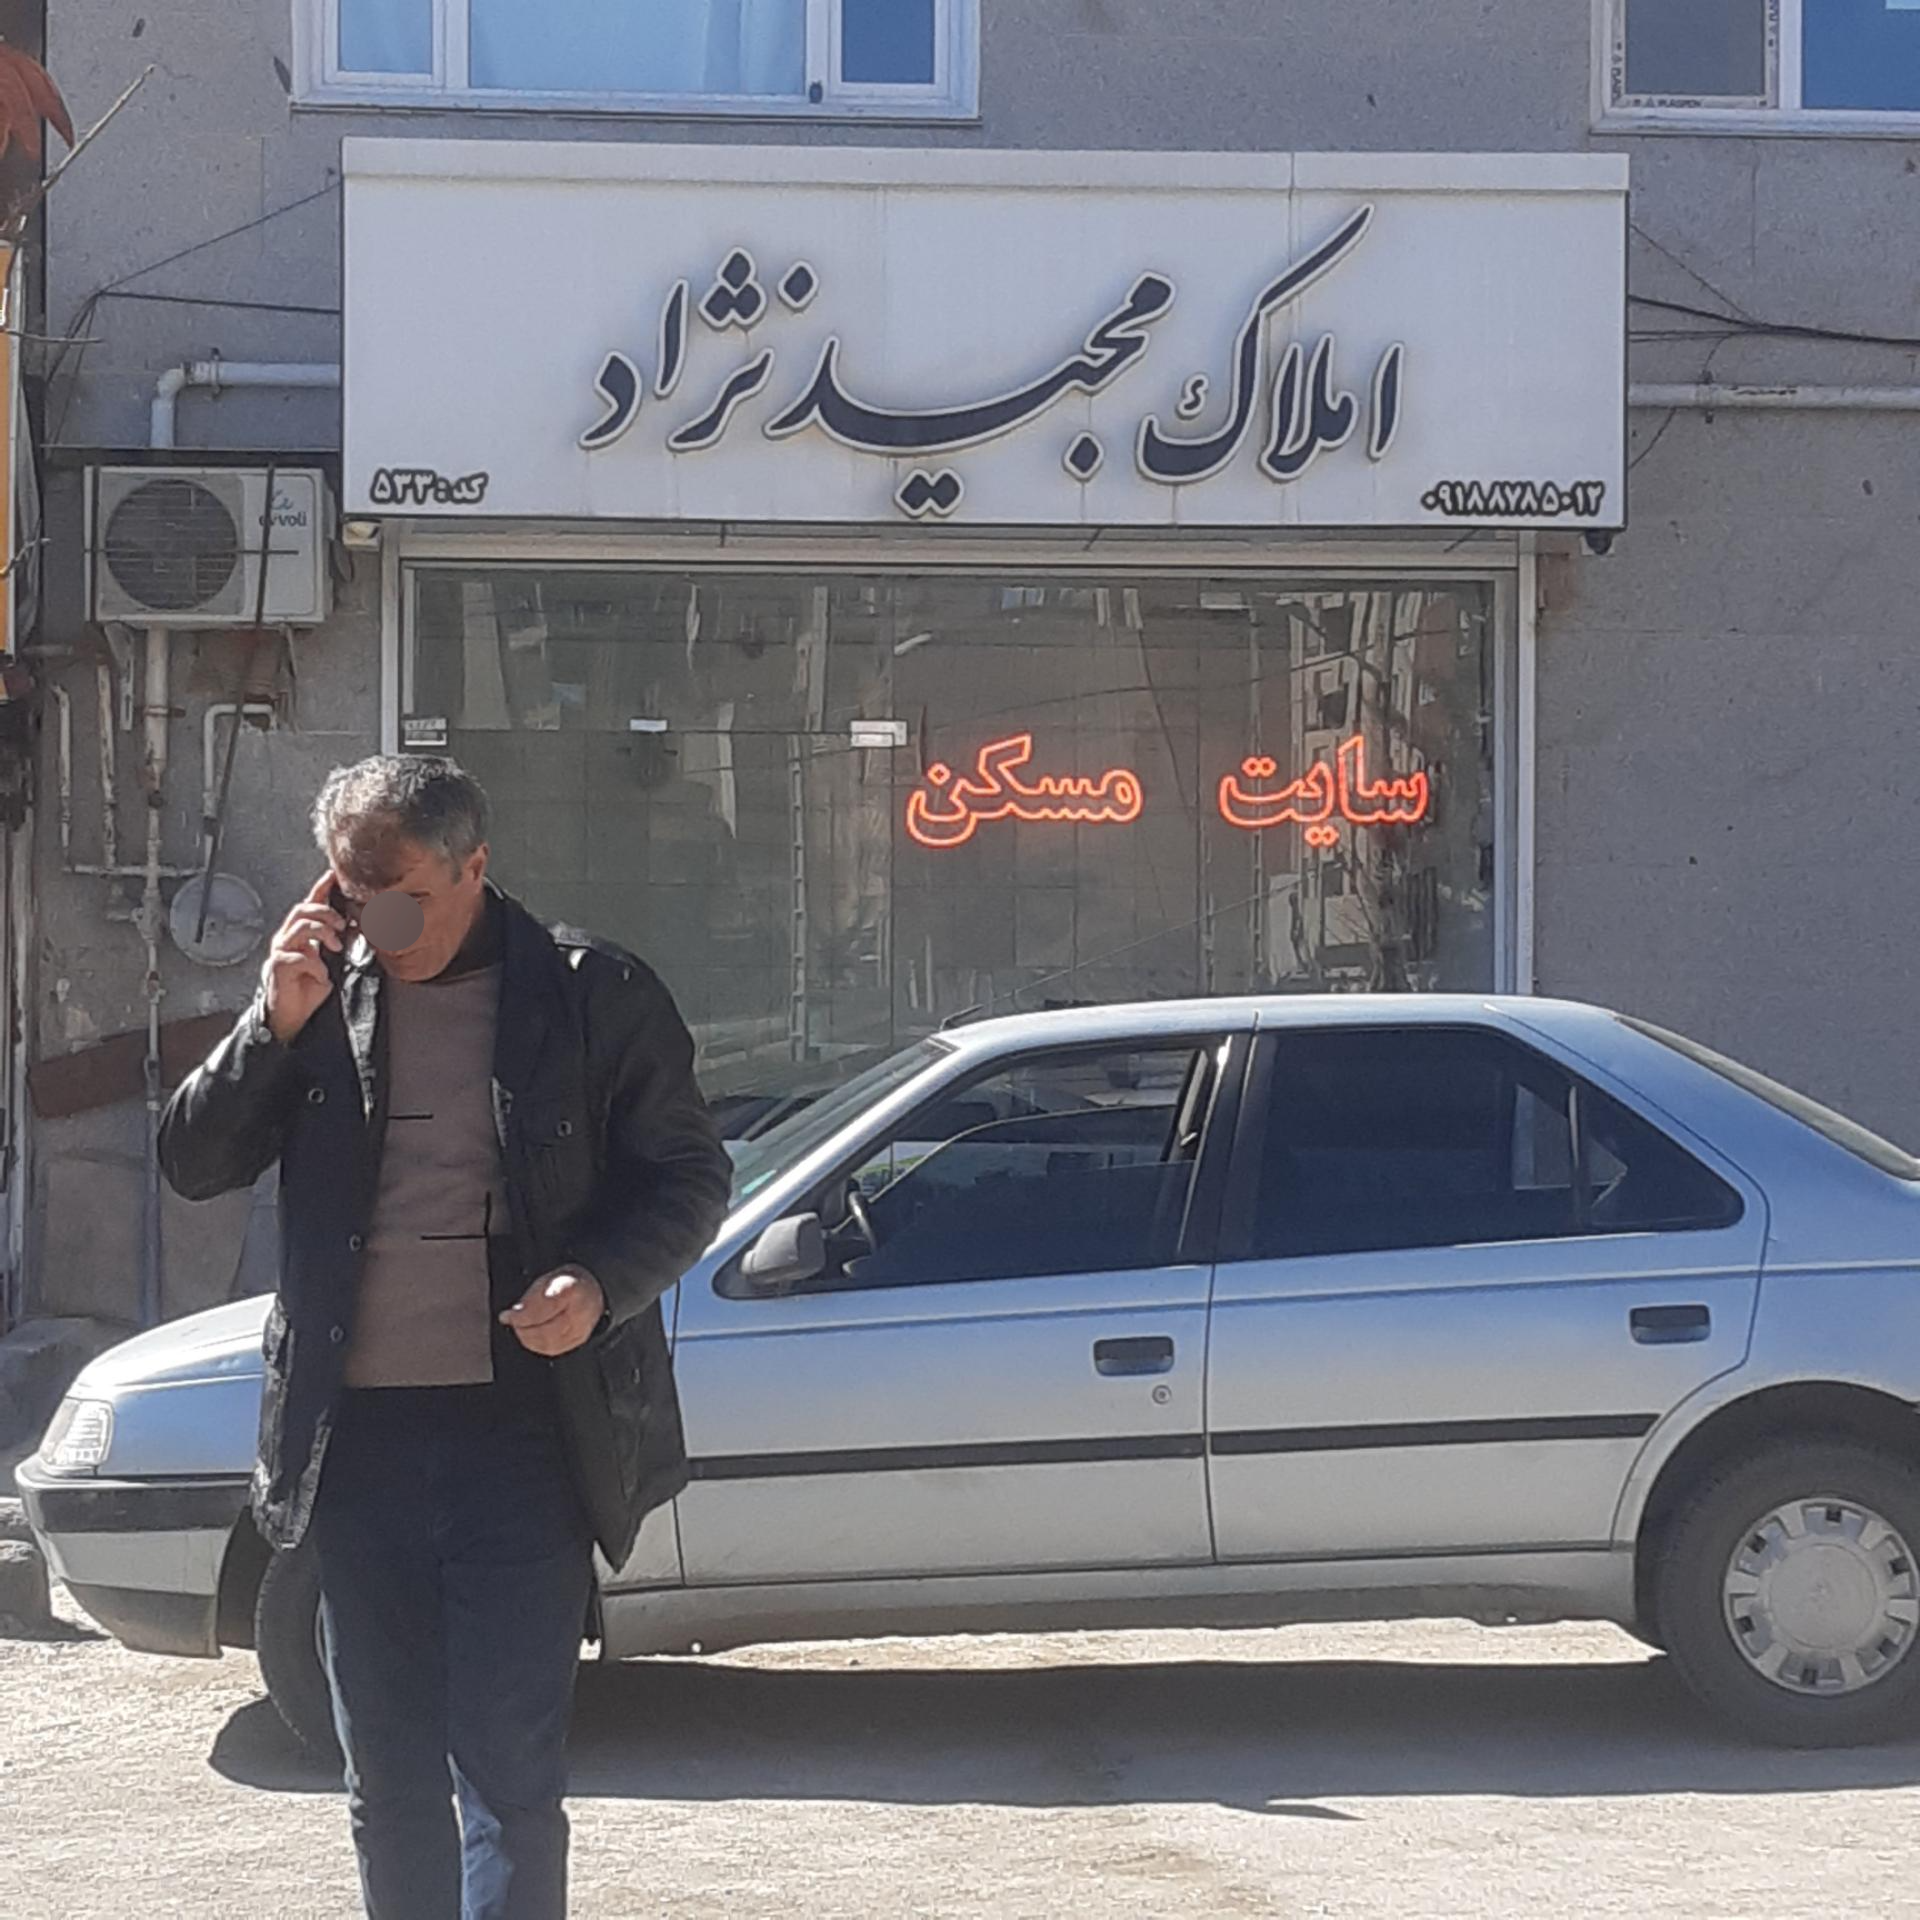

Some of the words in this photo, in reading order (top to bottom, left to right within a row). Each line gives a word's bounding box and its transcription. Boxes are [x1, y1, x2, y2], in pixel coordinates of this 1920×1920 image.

[1136, 204, 1404, 483] املاک
[905, 733, 1144, 849] مسکن
[1218, 734, 1430, 848] سایت
